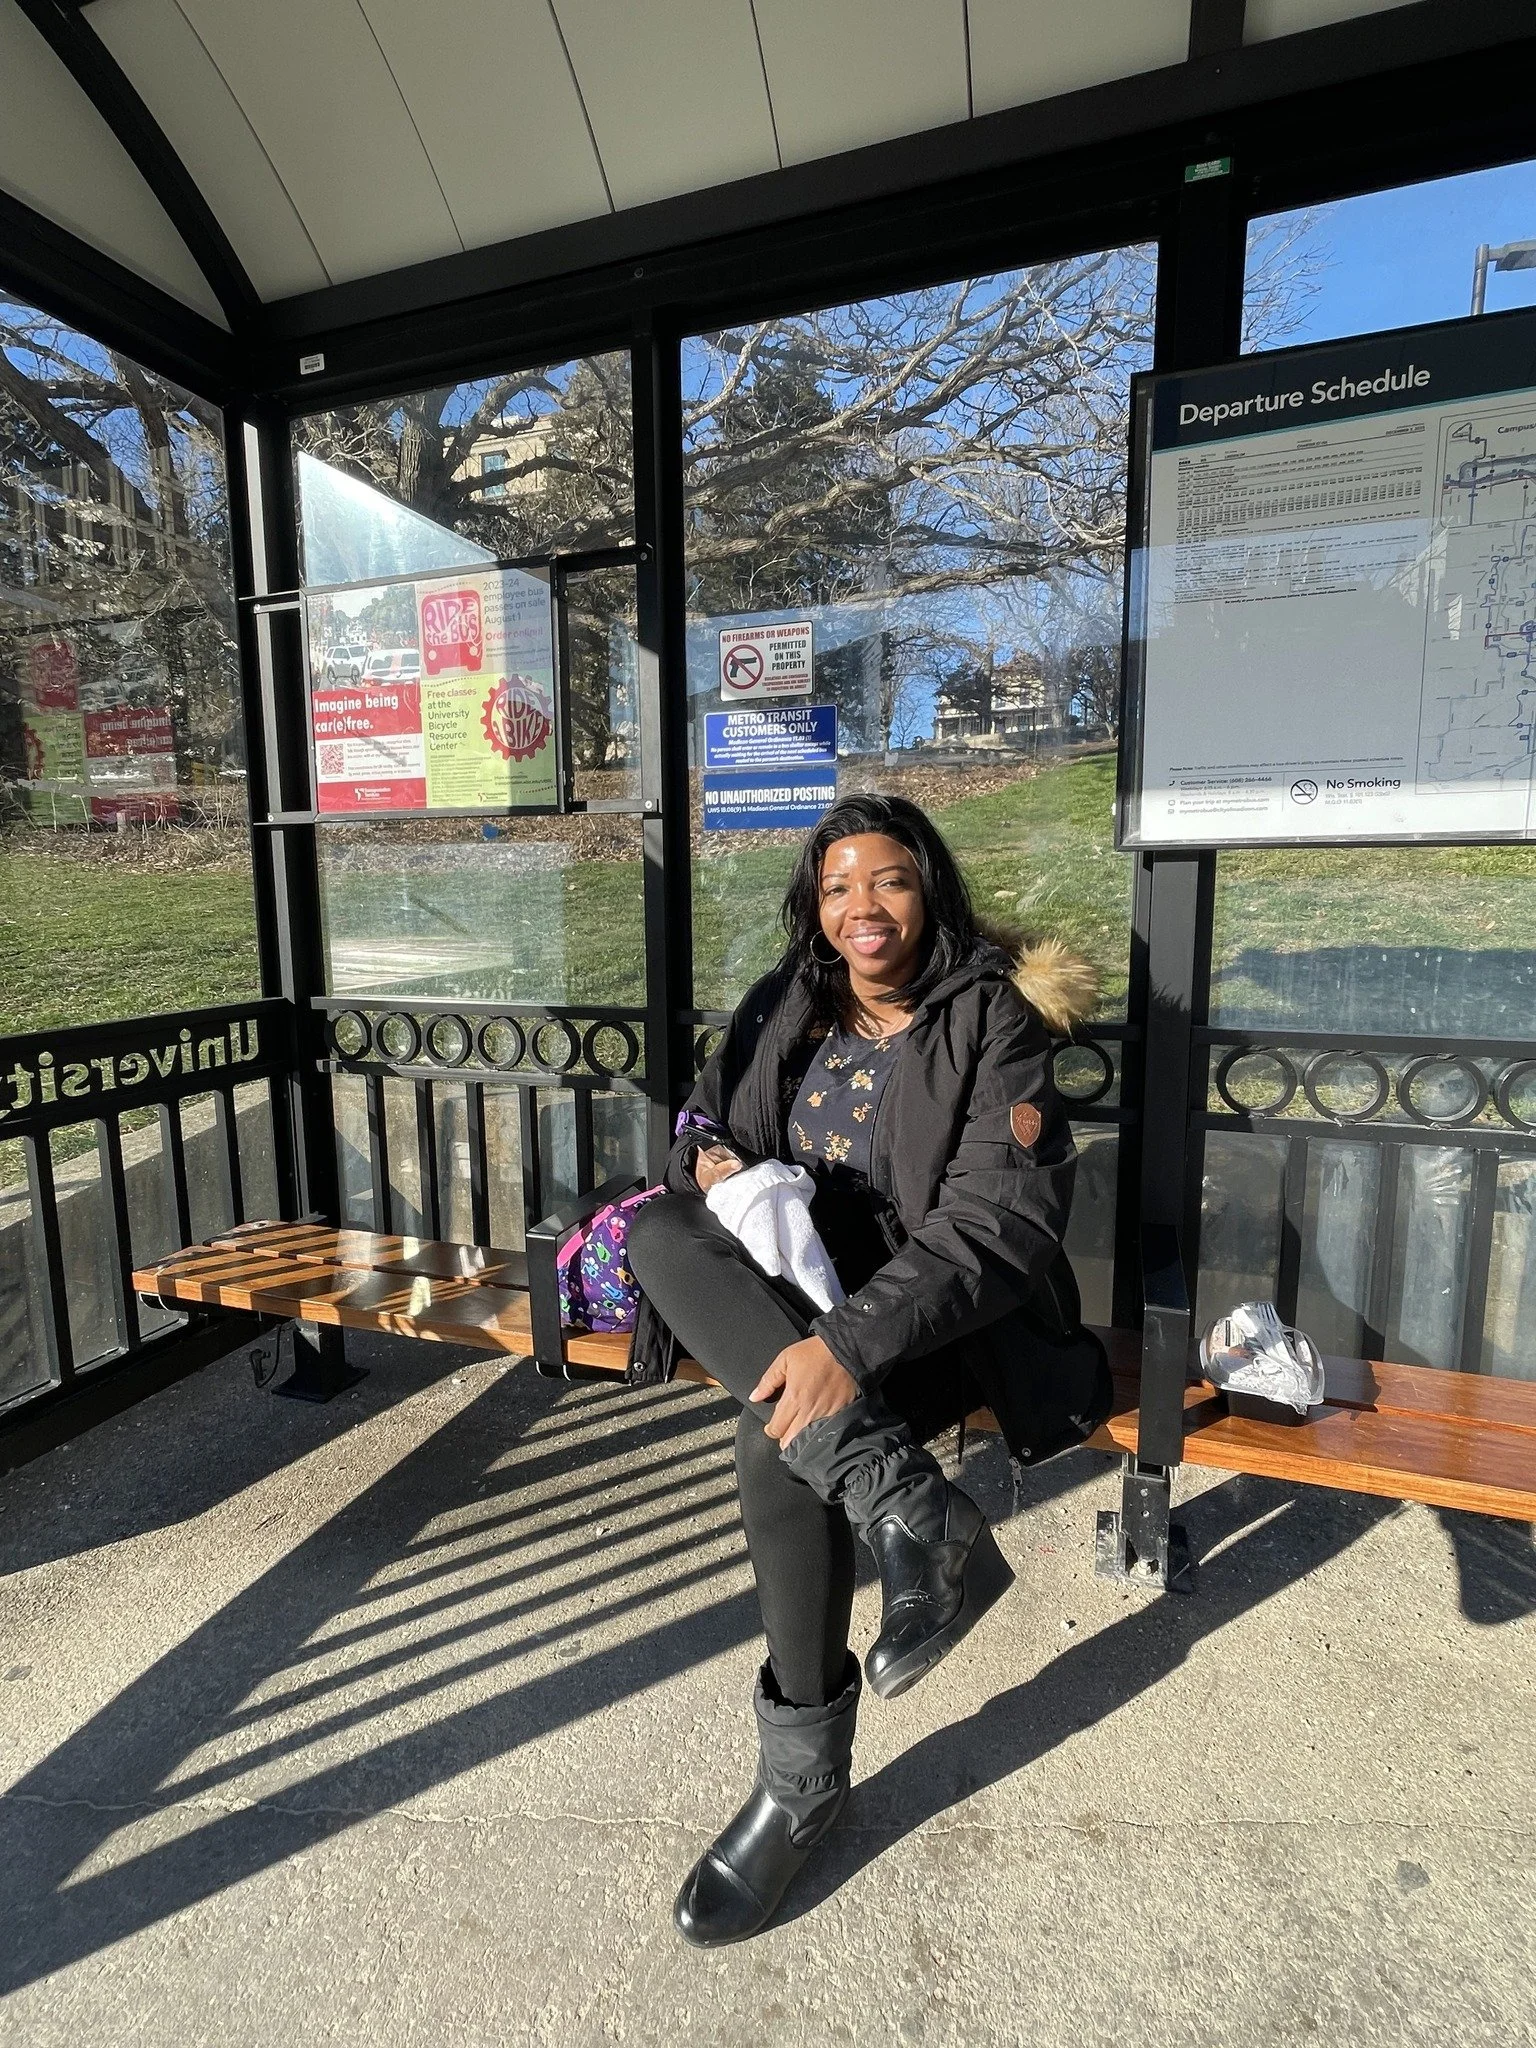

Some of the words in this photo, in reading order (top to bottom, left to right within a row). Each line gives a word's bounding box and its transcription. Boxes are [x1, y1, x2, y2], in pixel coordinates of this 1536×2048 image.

[1179, 390, 1304, 426] Departure
[1311, 365, 1431, 404] Schedule
[483, 578, 520, 591] 2023-24
[484, 588, 526, 602] employee
[527, 587, 544, 597] bus
[484, 602, 513, 614] passes
[515, 601, 527, 609] on
[528, 598, 546, 607] sale
[424, 599, 475, 635] RIDE
[485, 614, 515, 626] August
[517, 613, 522, 621] 1
[427, 632, 448, 645] the
[450, 614, 478, 643] BUS
[485, 629, 512, 641] Order
[722, 634, 731, 643] NO
[732, 631, 765, 642] FIREARMS
[766, 630, 775, 639] OR
[777, 627, 810, 638] WEAPONS
[769, 640, 806, 651] PERMITTED
[775, 651, 784, 661] ON
[785, 651, 801, 660] THIS
[772, 660, 806, 671] PROPERTY
[427, 690, 446, 699] Free
[447, 688, 477, 698] classes
[315, 696, 362, 714] Imagine
[365, 694, 399, 710] being
[427, 702, 437, 710] at
[437, 700, 452, 709] the
[495, 687, 541, 719] RIDE
[428, 709, 470, 720] University
[727, 713, 765, 726] METRO
[766, 709, 812, 722] TRANSIT
[315, 716, 374, 734] car(e)free.
[428, 721, 458, 732] Bicycle
[502, 711, 545, 748] BIKE
[722, 723, 786, 738] CUSTOMERS
[788, 721, 818, 734] ONLY
[429, 731, 468, 741] Resource
[430, 741, 458, 751] Center
[1326, 779, 1344, 790] No
[1347, 777, 1401, 790] Smoking
[705, 791, 719, 805] NO
[720, 788, 792, 805] UNAUTHORIZED
[793, 786, 836, 802] POSTING
[769, 804, 790, 812] General
